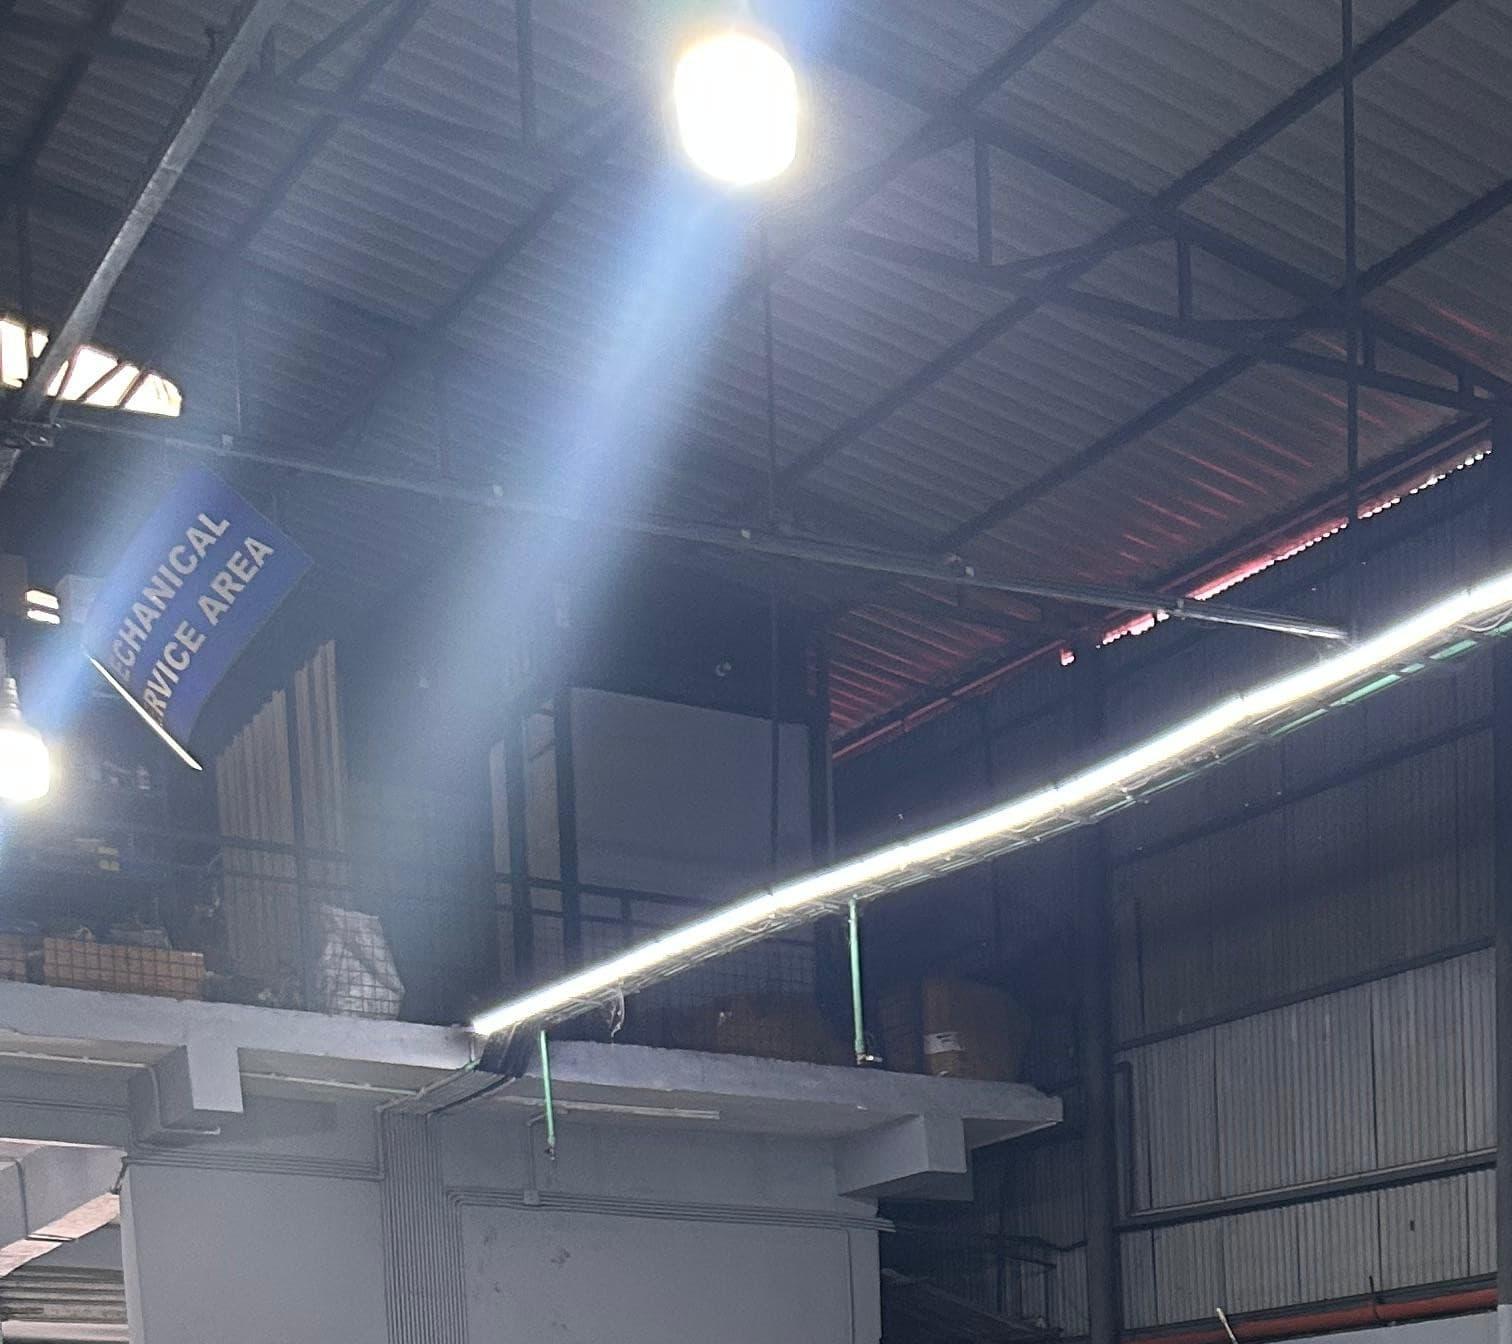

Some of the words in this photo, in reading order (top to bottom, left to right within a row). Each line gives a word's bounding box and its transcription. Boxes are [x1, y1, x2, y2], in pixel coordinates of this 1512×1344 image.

[109, 513, 231, 682] ECHANICAL
[143, 620, 207, 718] RVICE
[198, 536, 275, 626] AREA
